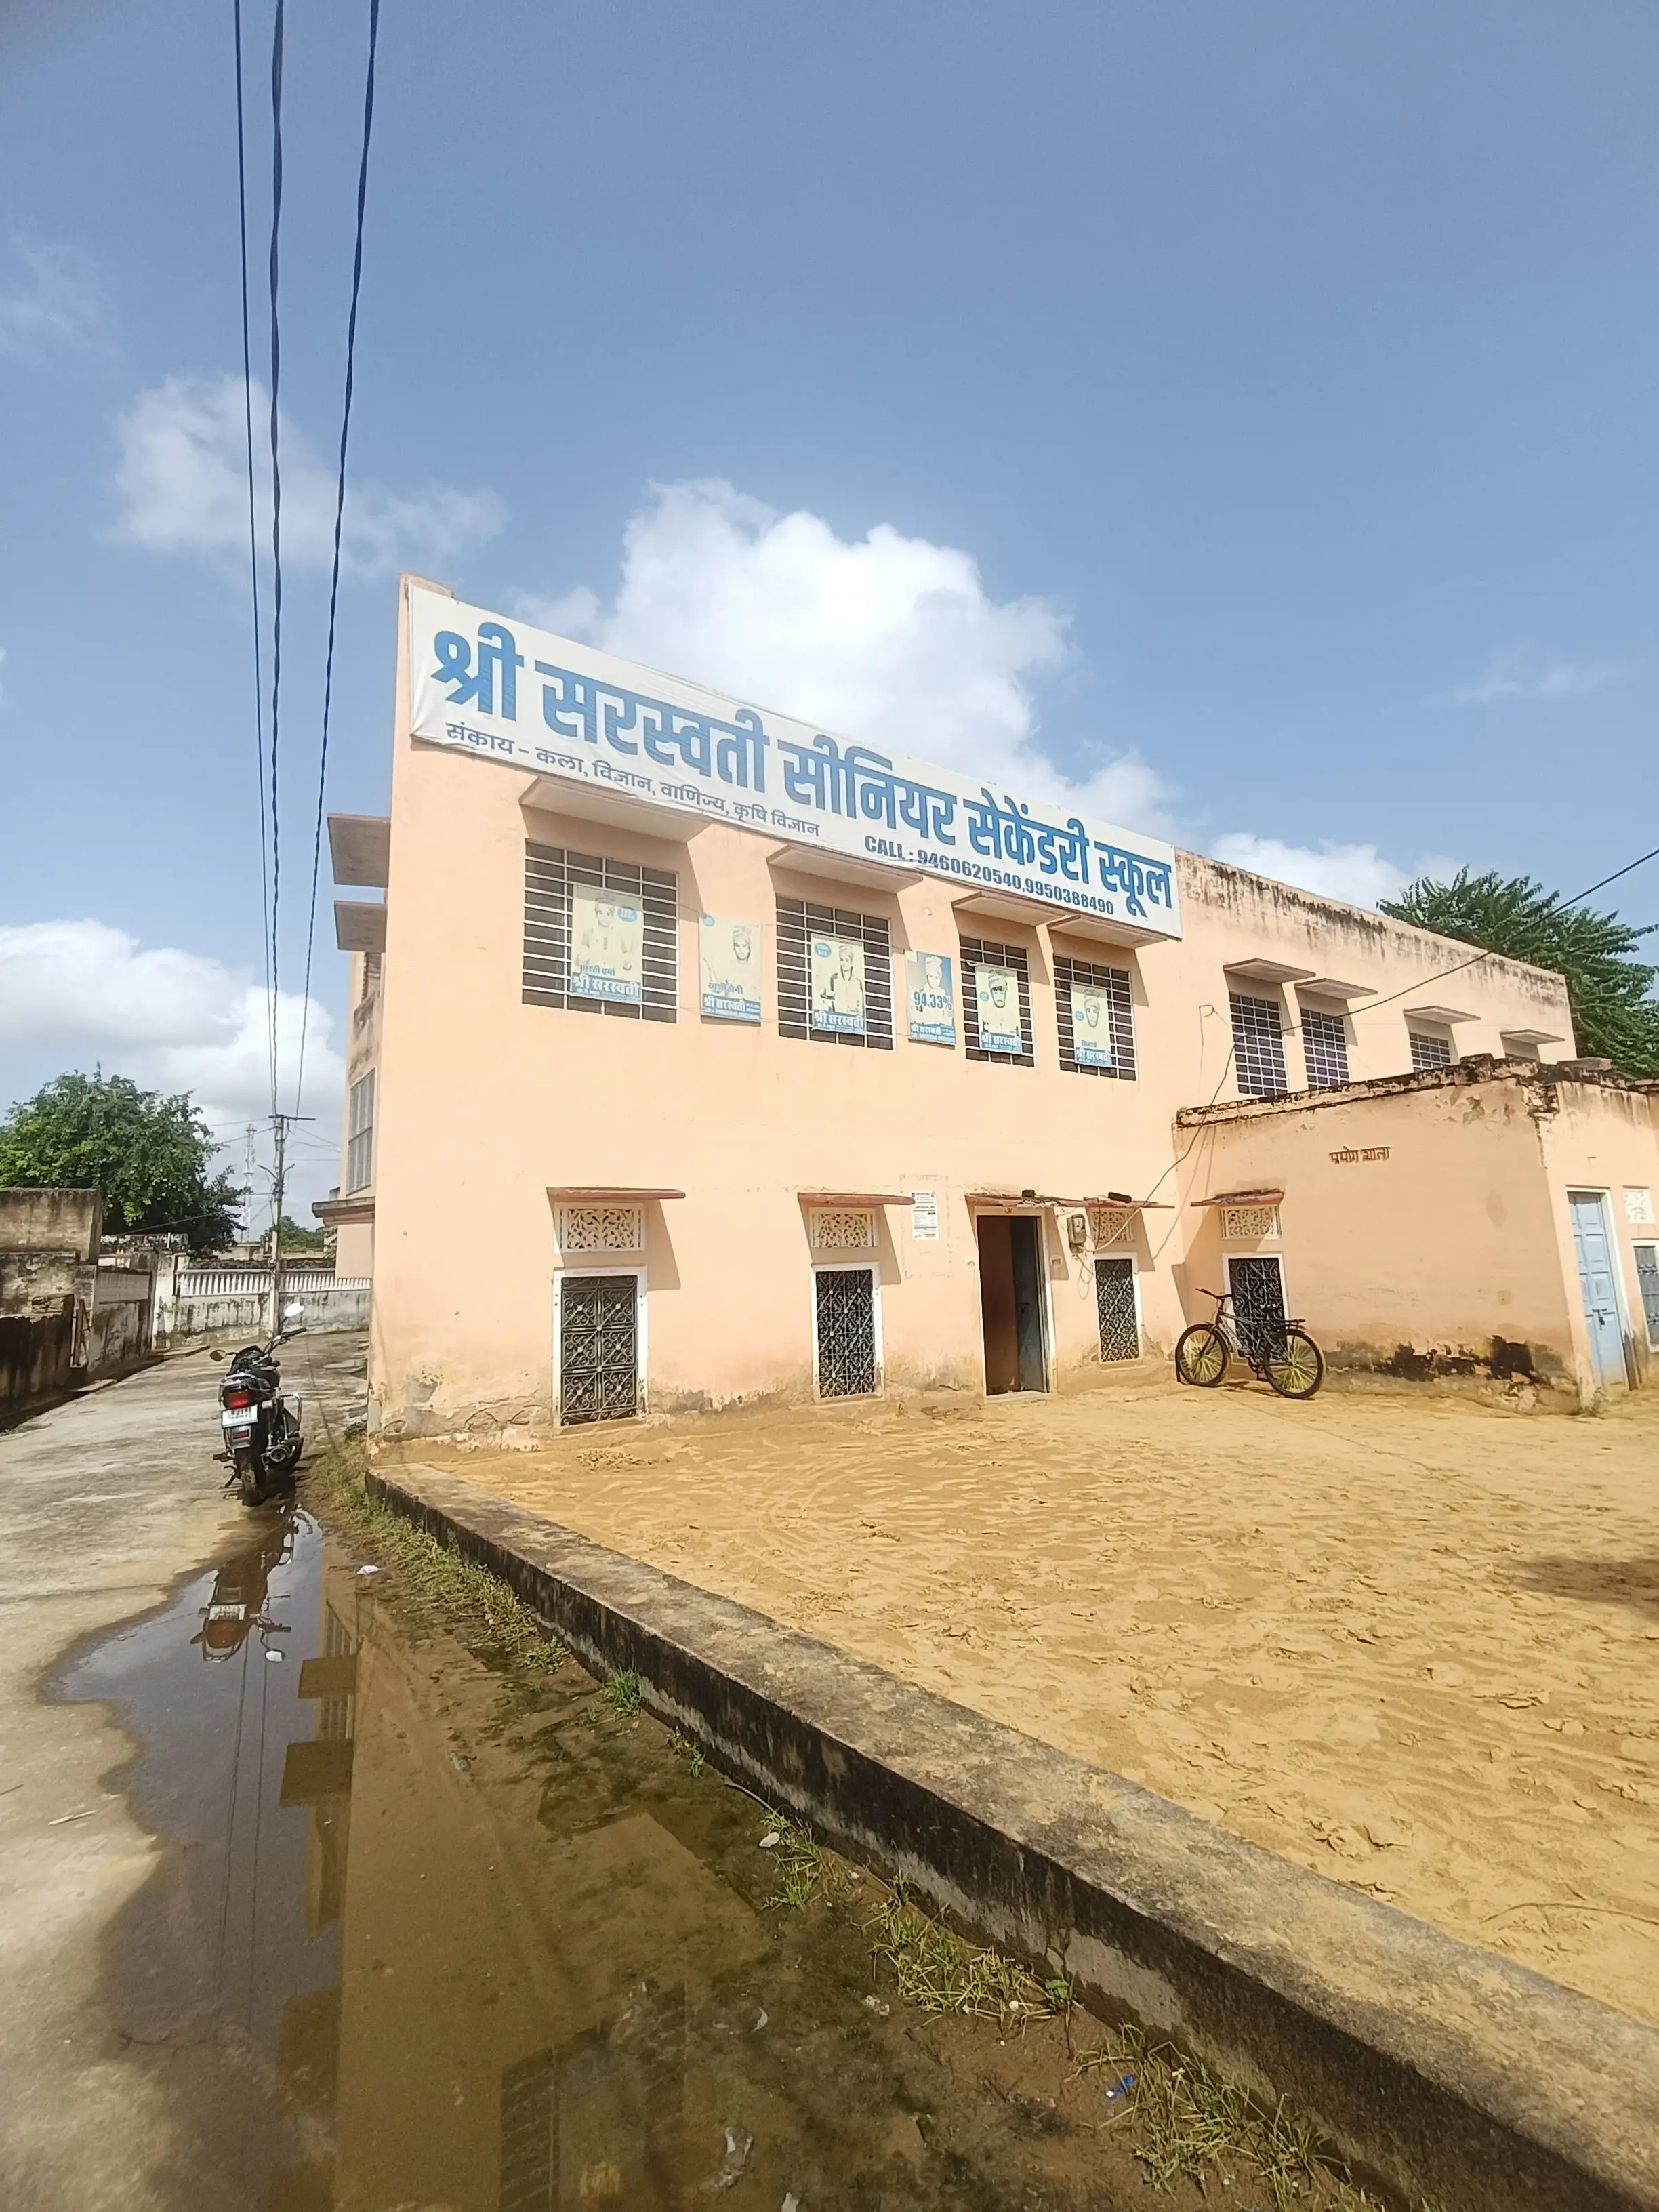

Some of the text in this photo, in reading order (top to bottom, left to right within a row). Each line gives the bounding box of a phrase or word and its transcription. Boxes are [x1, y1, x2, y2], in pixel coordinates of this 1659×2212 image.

[431, 622, 1172, 918] श्री सरस्वती सीनियर सेकेंडरी स्कूल
[446, 722, 514, 754] संकाय
[733, 802, 767, 825] कृषि
[771, 810, 819, 836] विज्ञान
[573, 973, 590, 989] श्री
[593, 978, 640, 996] सरस्वती
[704, 996, 715, 1008] श्री
[716, 998, 746, 1012] सरस्वती
[914, 991, 952, 1011] 94.33%
[814, 1010, 827, 1023] श्री
[828, 1014, 863, 1029] सरस्वती
